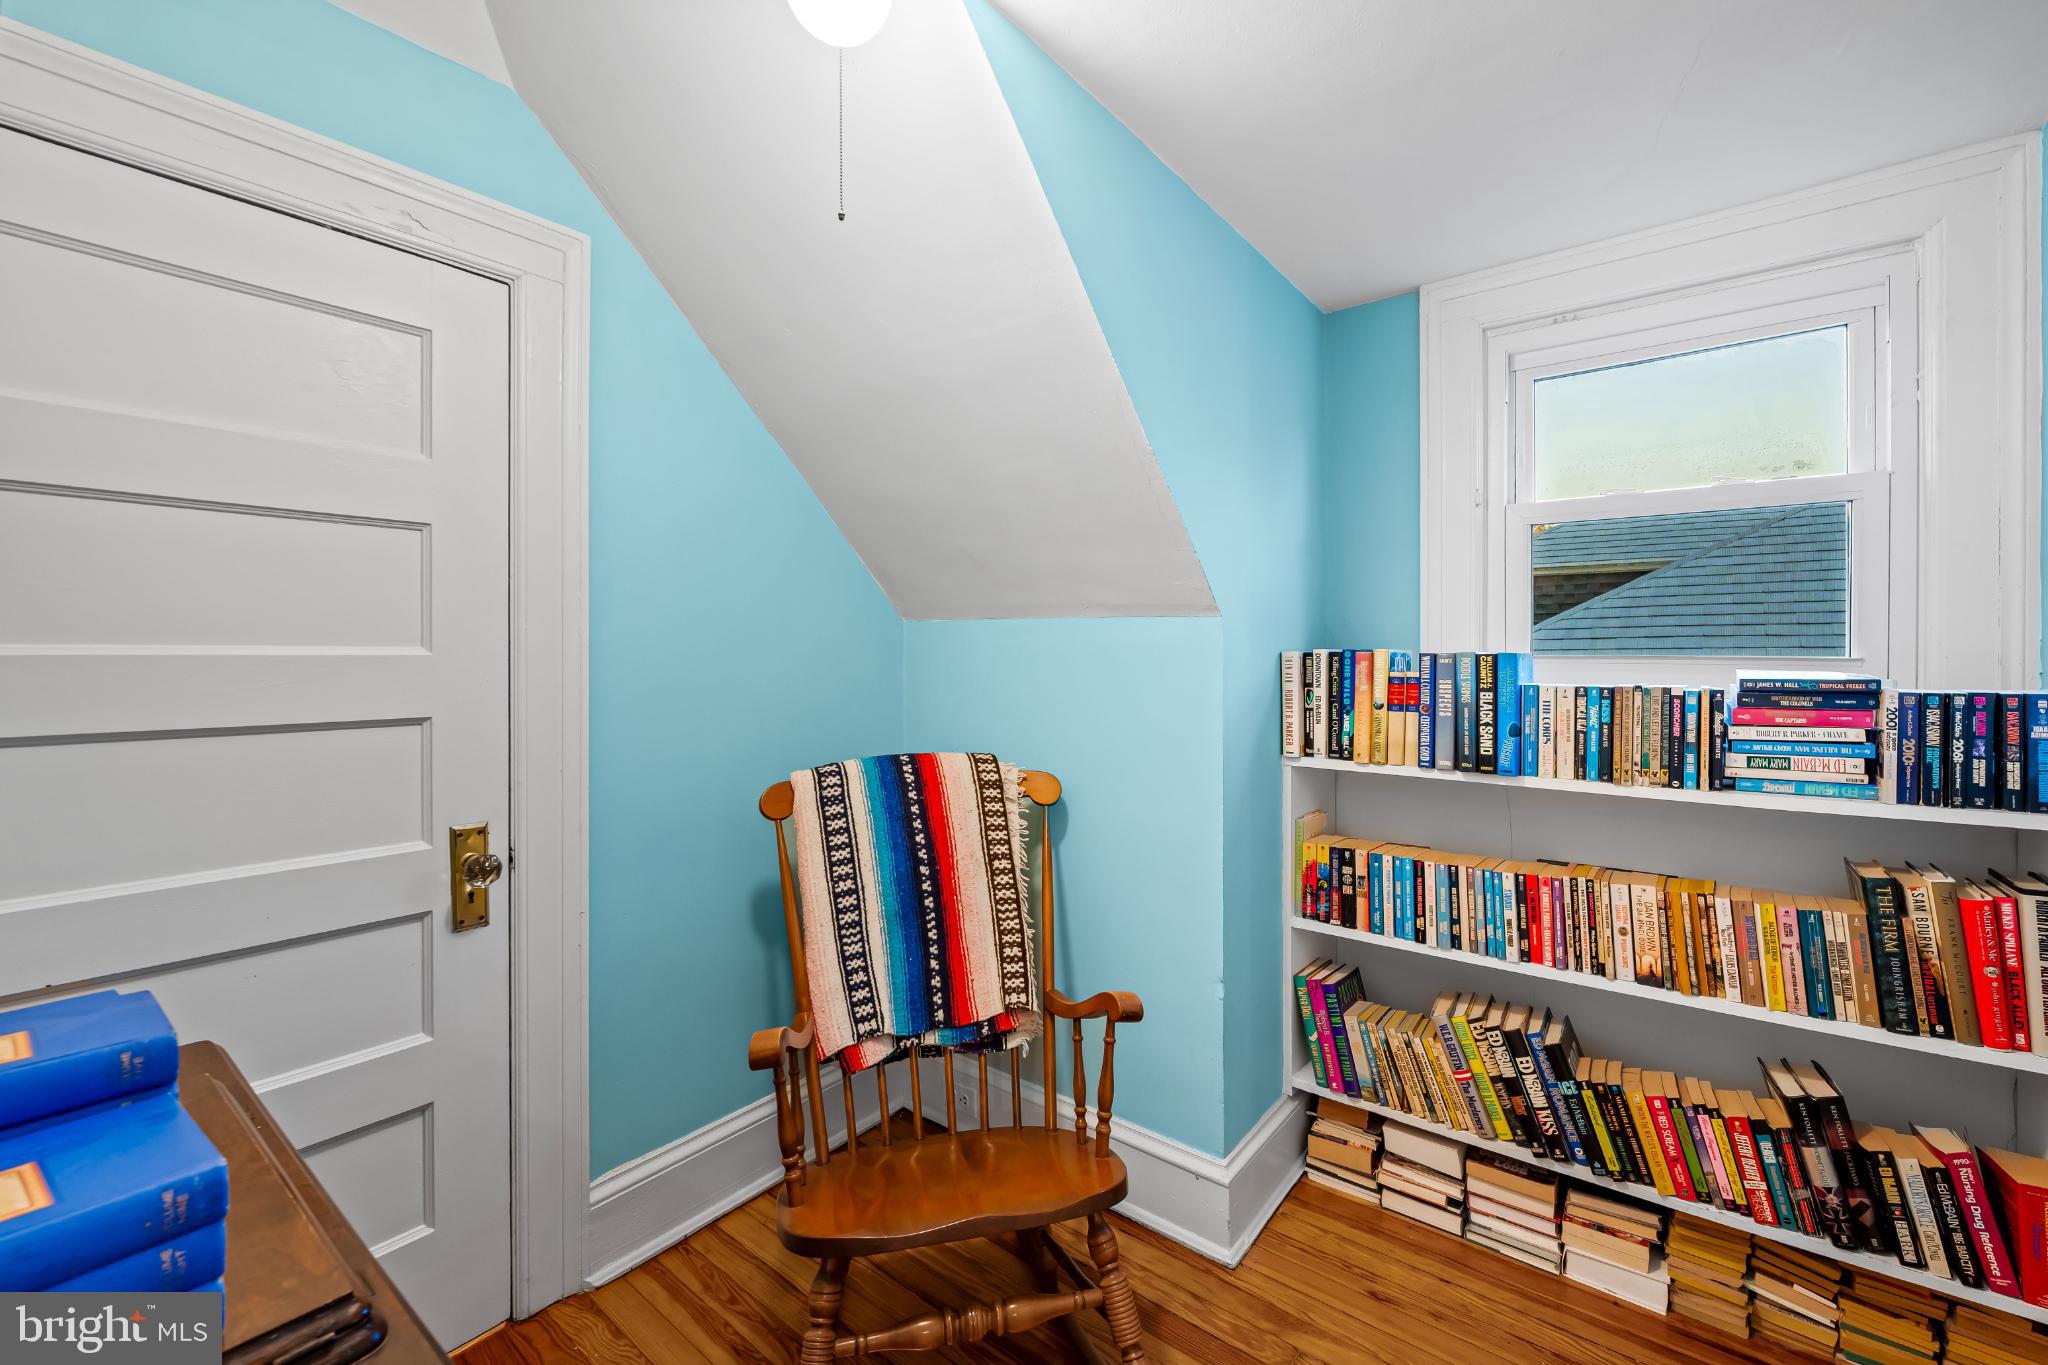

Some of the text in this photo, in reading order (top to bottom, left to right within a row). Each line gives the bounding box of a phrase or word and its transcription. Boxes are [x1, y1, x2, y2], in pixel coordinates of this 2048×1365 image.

[1461, 658, 1471, 679] POODLE
[1439, 680, 1452, 716] SUSPECTS
[1480, 692, 1493, 724] BLACK
[1602, 699, 1610, 723] KISS
[1285, 720, 1294, 746] PARKER
[1543, 717, 1551, 745] CORPS
[1673, 698, 1681, 737] SCORCHER
[1756, 729, 1781, 738] ROBERT
[1790, 730, 1816, 738] PARKER
[1823, 730, 1849, 739] CHANCE
[1886, 707, 1898, 730] 2001
[1480, 726, 1493, 755] SAND
[1903, 738, 1915, 765] 2010:
[1926, 727, 1940, 746] ASIMOV
[1952, 739, 1964, 763] 2061:
[2007, 727, 2019, 745] ASIMOV
[1420, 747, 1430, 761] GOLD
[1750, 757, 1788, 768] MARY MARY
[1793, 758, 1846, 773] ED McBAIN
[1644, 902, 1656, 952] DAN BROWN
[1876, 886, 1900, 952] THE FIRM
[1911, 892, 1934, 955] SAM BOURNE
[1947, 918, 1957, 946] FRANK
[1984, 910, 1994, 939] Marley
[2001, 902, 2018, 967] MICKEY SPILLANE
[1890, 957, 1908, 1019] JOHN GRISHAM
[1923, 970, 1935, 995] FINAL
[1326, 993, 1343, 1027] PASTIME
[2008, 971, 2024, 1030] BLACK ALLEY
[1471, 1020, 1486, 1040] ED
[1993, 1006, 2002, 1032] grogan
[1438, 1023, 1465, 1071] W.E.B. GRIFFIN
[1487, 1028, 1517, 1078] ED McBAIN
[1516, 1056, 1558, 1135] ED McBAIN KISS
[1531, 1037, 1580, 1142] ED McBAIN ROMANCE
[1558, 1080, 1578, 1095] ICE
[1461, 1080, 1484, 1131] The Murderers
[1569, 1098, 1587, 1136] Ed McBain
[1615, 1095, 1634, 1137] MIAMI BLUES
[1658, 1115, 1678, 1157] RED SCREAM
[1799, 1102, 1817, 1144] KEN FOLLETT
[1830, 1105, 1848, 1149] KEN FOLLETT
[1734, 1132, 1760, 1182] JEFFERY DEAVER
[1760, 1141, 1776, 1164] DEAVER
[1844, 1151, 1860, 1186] JACKDAWS
[1879, 1166, 1893, 1176] ED
[1751, 1194, 1764, 1221] BEASTS
[1759, 1189, 1773, 1223] GARDEN
[1937, 1183, 1958, 1228] Ed McBAIN
[1959, 1168, 2001, 1277] Nursing Drug Reference
[1895, 1220, 1917, 1263] HARK!
[1952, 1232, 1974, 1277] BIG BAD CITY
